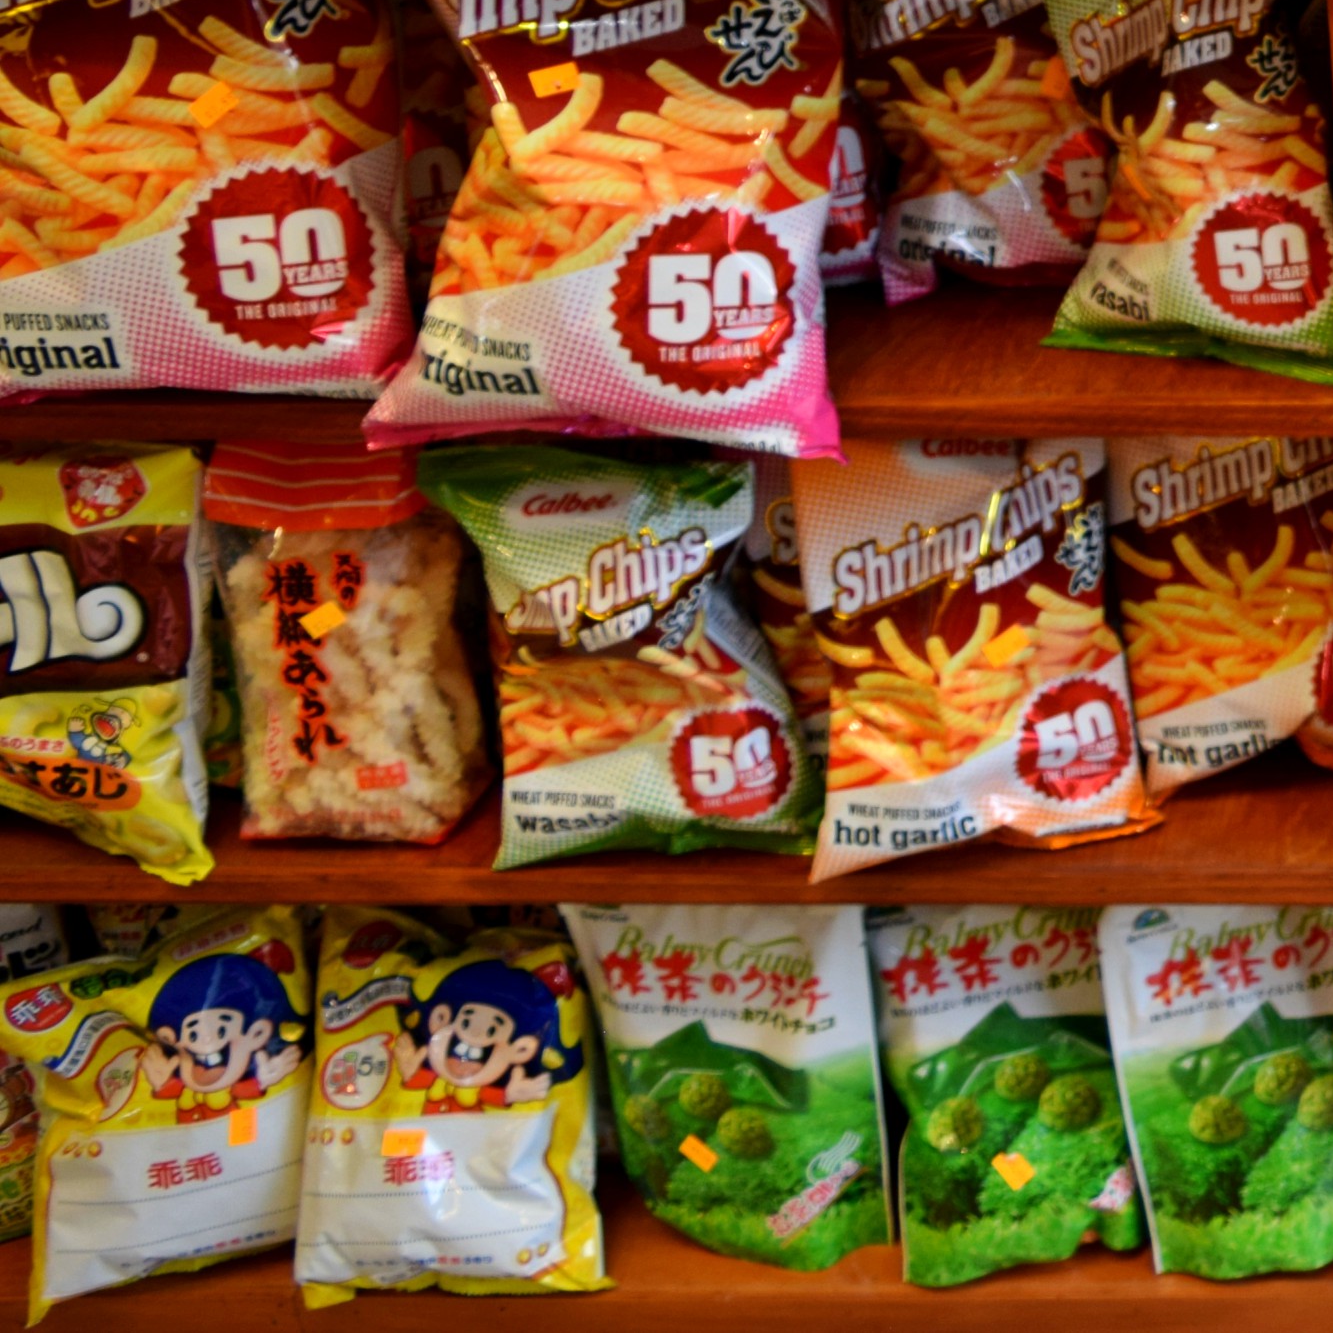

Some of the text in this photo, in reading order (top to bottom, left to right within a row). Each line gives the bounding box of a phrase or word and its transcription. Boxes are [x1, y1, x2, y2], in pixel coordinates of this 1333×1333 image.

[658, 341, 760, 362] THE ORIGINAL
[521, 490, 616, 518] Calbee
[587, 527, 706, 620] Chips
[833, 515, 980, 614] Shrimp
[974, 536, 1044, 594] BAKED
[833, 814, 979, 849] hot garlic
[147, 1152, 223, 1190] 乖乖
